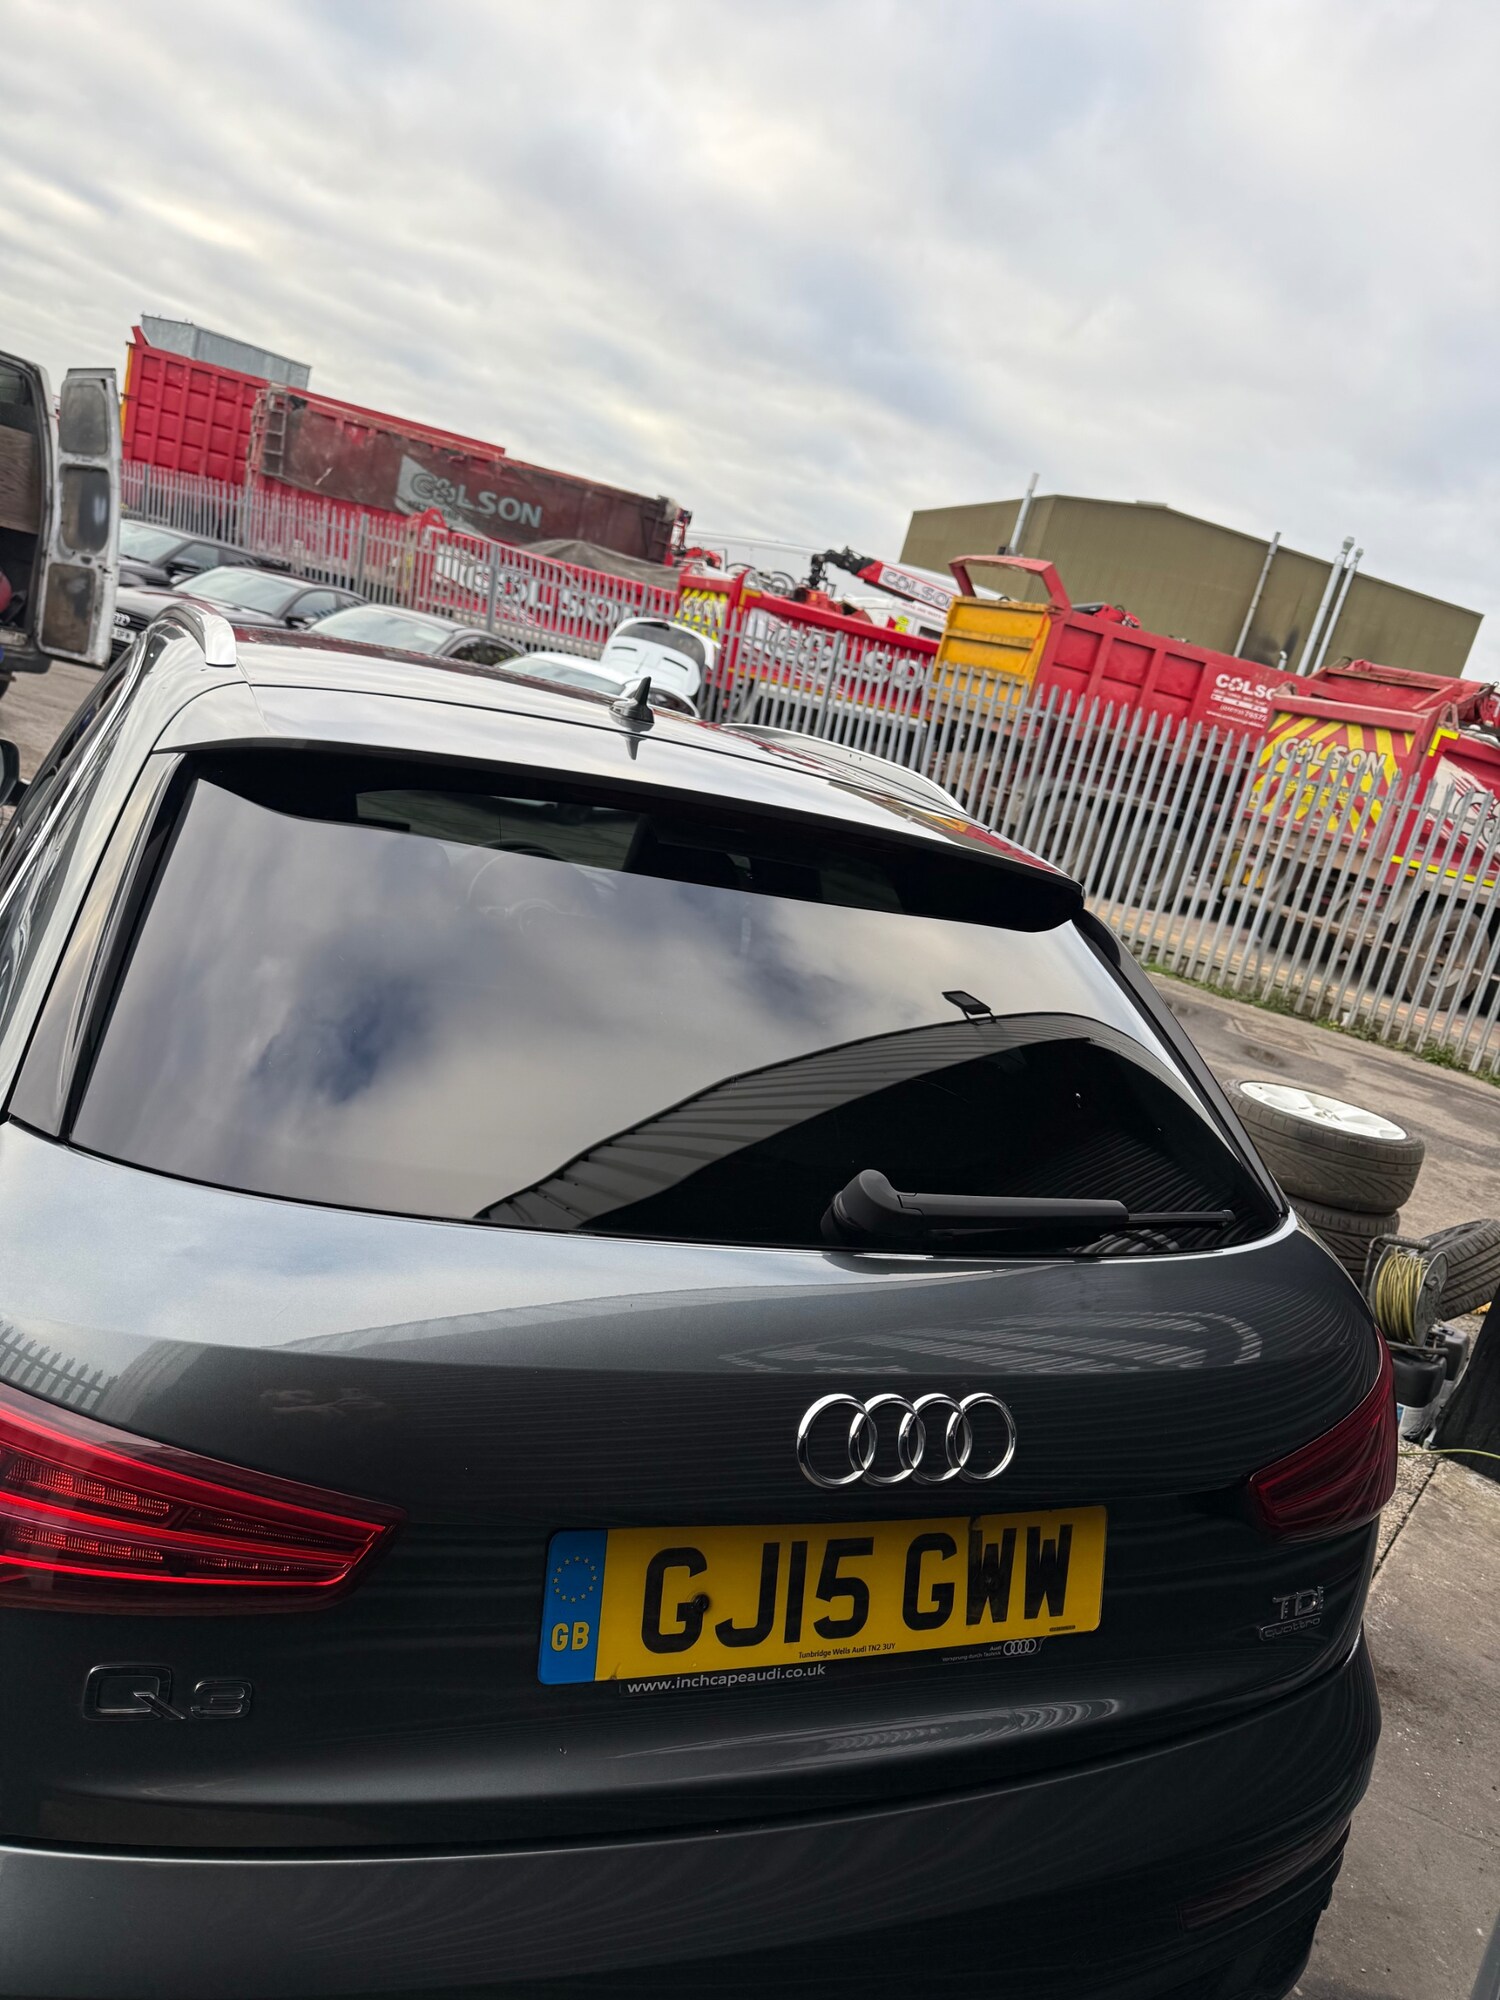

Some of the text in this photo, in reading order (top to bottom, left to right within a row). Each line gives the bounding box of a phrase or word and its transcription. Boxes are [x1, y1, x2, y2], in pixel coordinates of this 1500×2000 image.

[410, 472, 543, 529] COLSON
[1280, 737, 1388, 778] COLSON
[641, 1523, 1074, 1655] GJ15 GWW
[1272, 1585, 1324, 1619] TDI
[550, 1621, 590, 1652] GB
[1264, 1617, 1321, 1639] quattro
[798, 1642, 897, 1659] Tunbridge Wells Audi TN2 3UY
[82, 1663, 253, 1722] Q3
[626, 1664, 827, 1694] www.inchcapeaudi.co.uk
